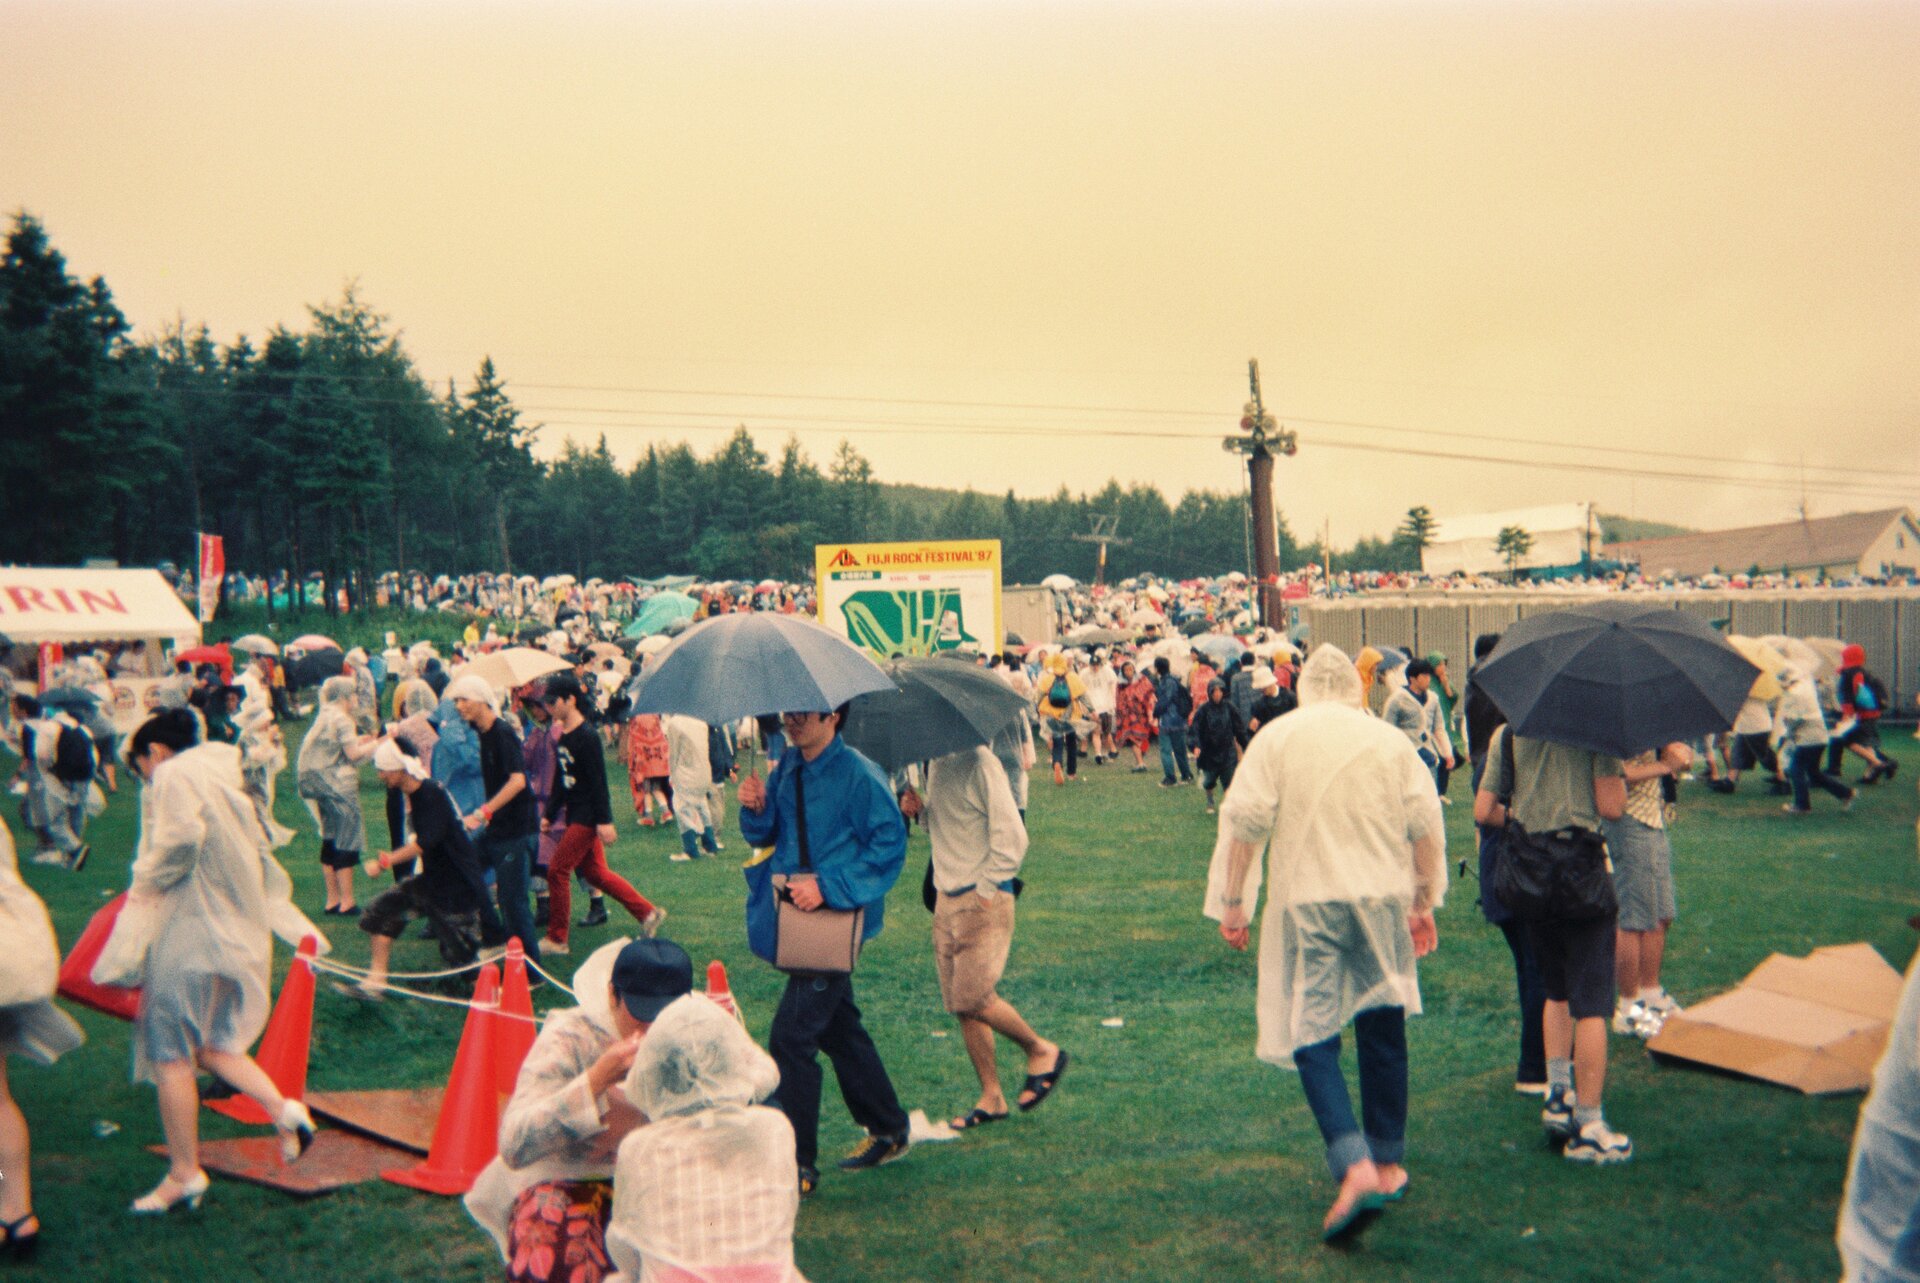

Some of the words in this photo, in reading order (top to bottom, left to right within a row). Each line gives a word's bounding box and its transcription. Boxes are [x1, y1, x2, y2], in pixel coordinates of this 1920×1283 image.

[867, 553, 891, 565] FUJI
[893, 553, 922, 564] ROCK
[925, 551, 974, 563] FESTIVAL
[0, 586, 129, 614] RIN
